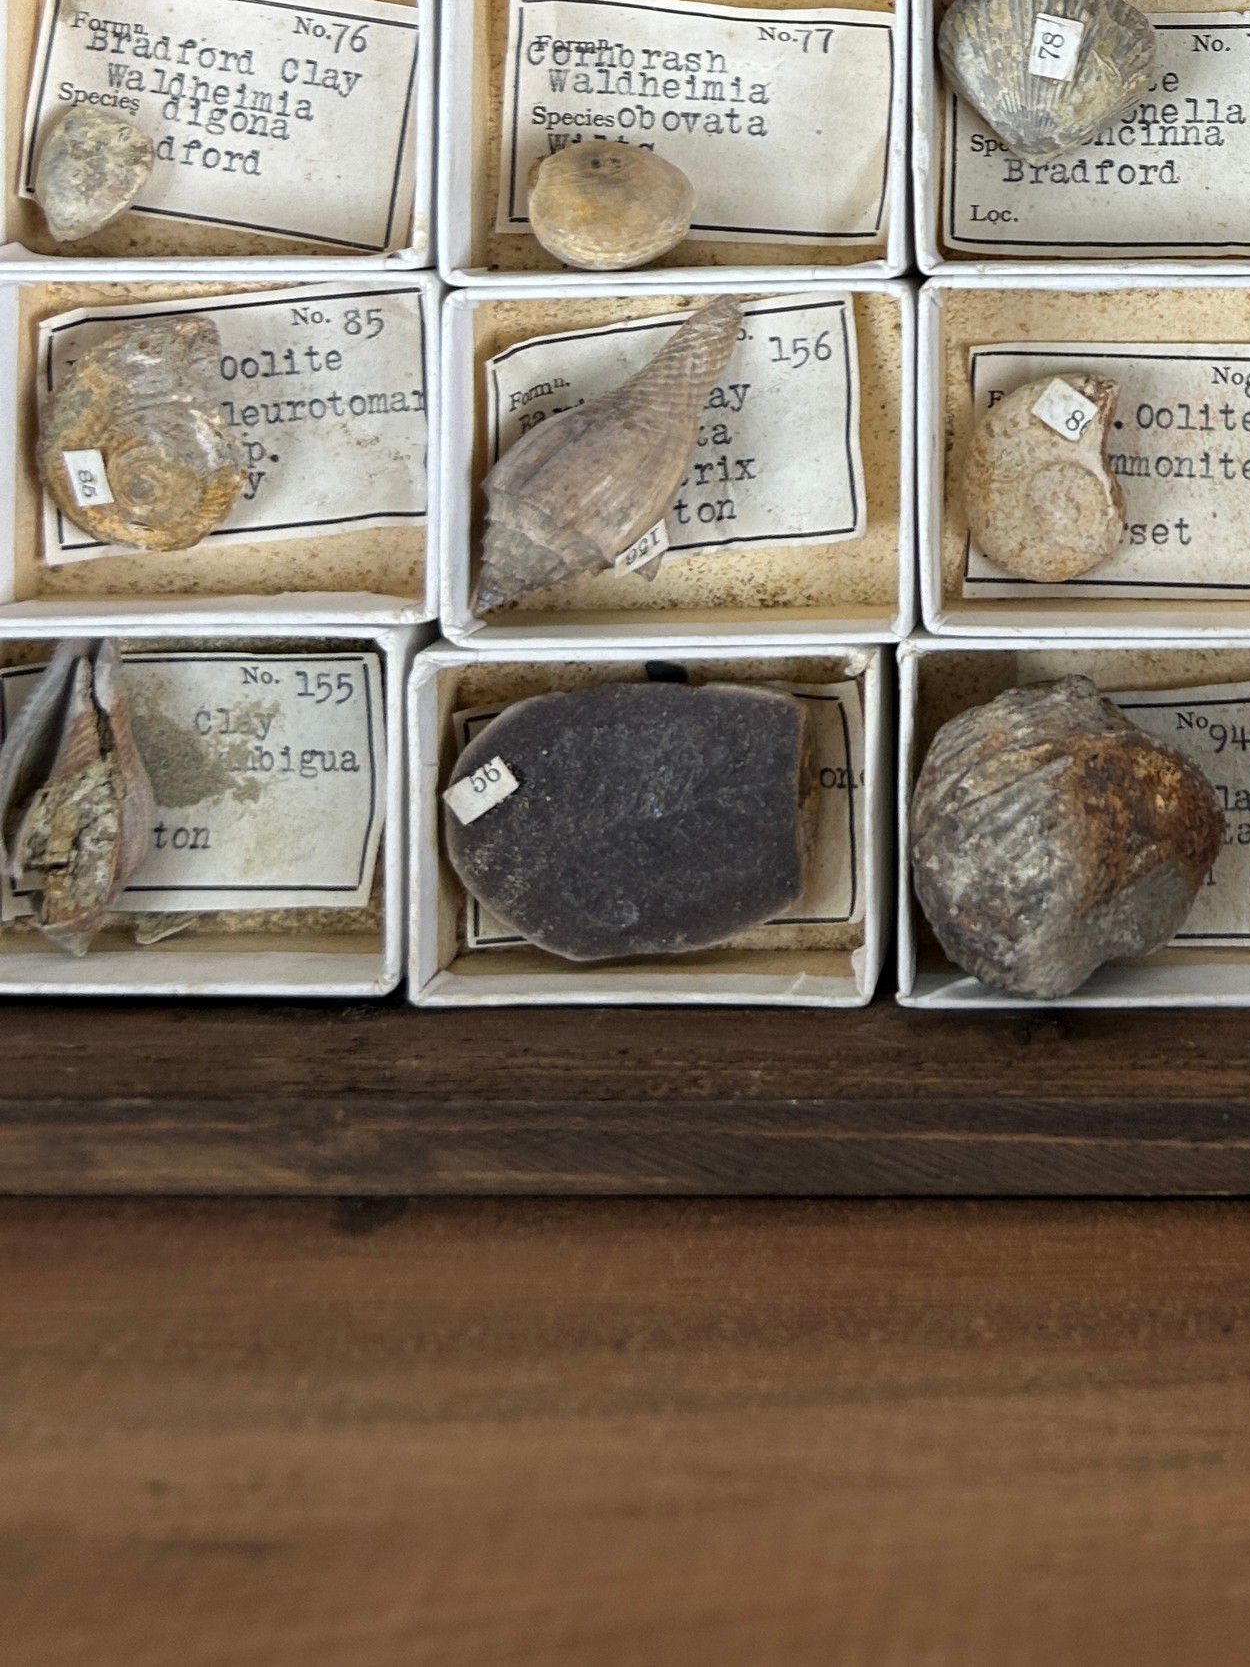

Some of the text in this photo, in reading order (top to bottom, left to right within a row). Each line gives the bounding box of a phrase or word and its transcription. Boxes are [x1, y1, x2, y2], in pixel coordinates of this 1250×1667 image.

[292, 16, 369, 54] No. 76
[757, 26, 835, 55] No. 77
[1038, 31, 1065, 60] 78
[1191, 34, 1231, 53] No.
[85, 33, 363, 98] Bradford Clay
[106, 62, 315, 122] Waldheimia
[547, 68, 770, 104] Waldheimia
[57, 82, 291, 141] Species digona
[532, 105, 616, 129] Species
[1002, 158, 1181, 186] Bradford
[970, 205, 1019, 223] Loc.
[290, 307, 385, 339] No. 85
[220, 347, 344, 381] Oolite
[769, 334, 833, 368] 156
[241, 667, 355, 704] No. 155
